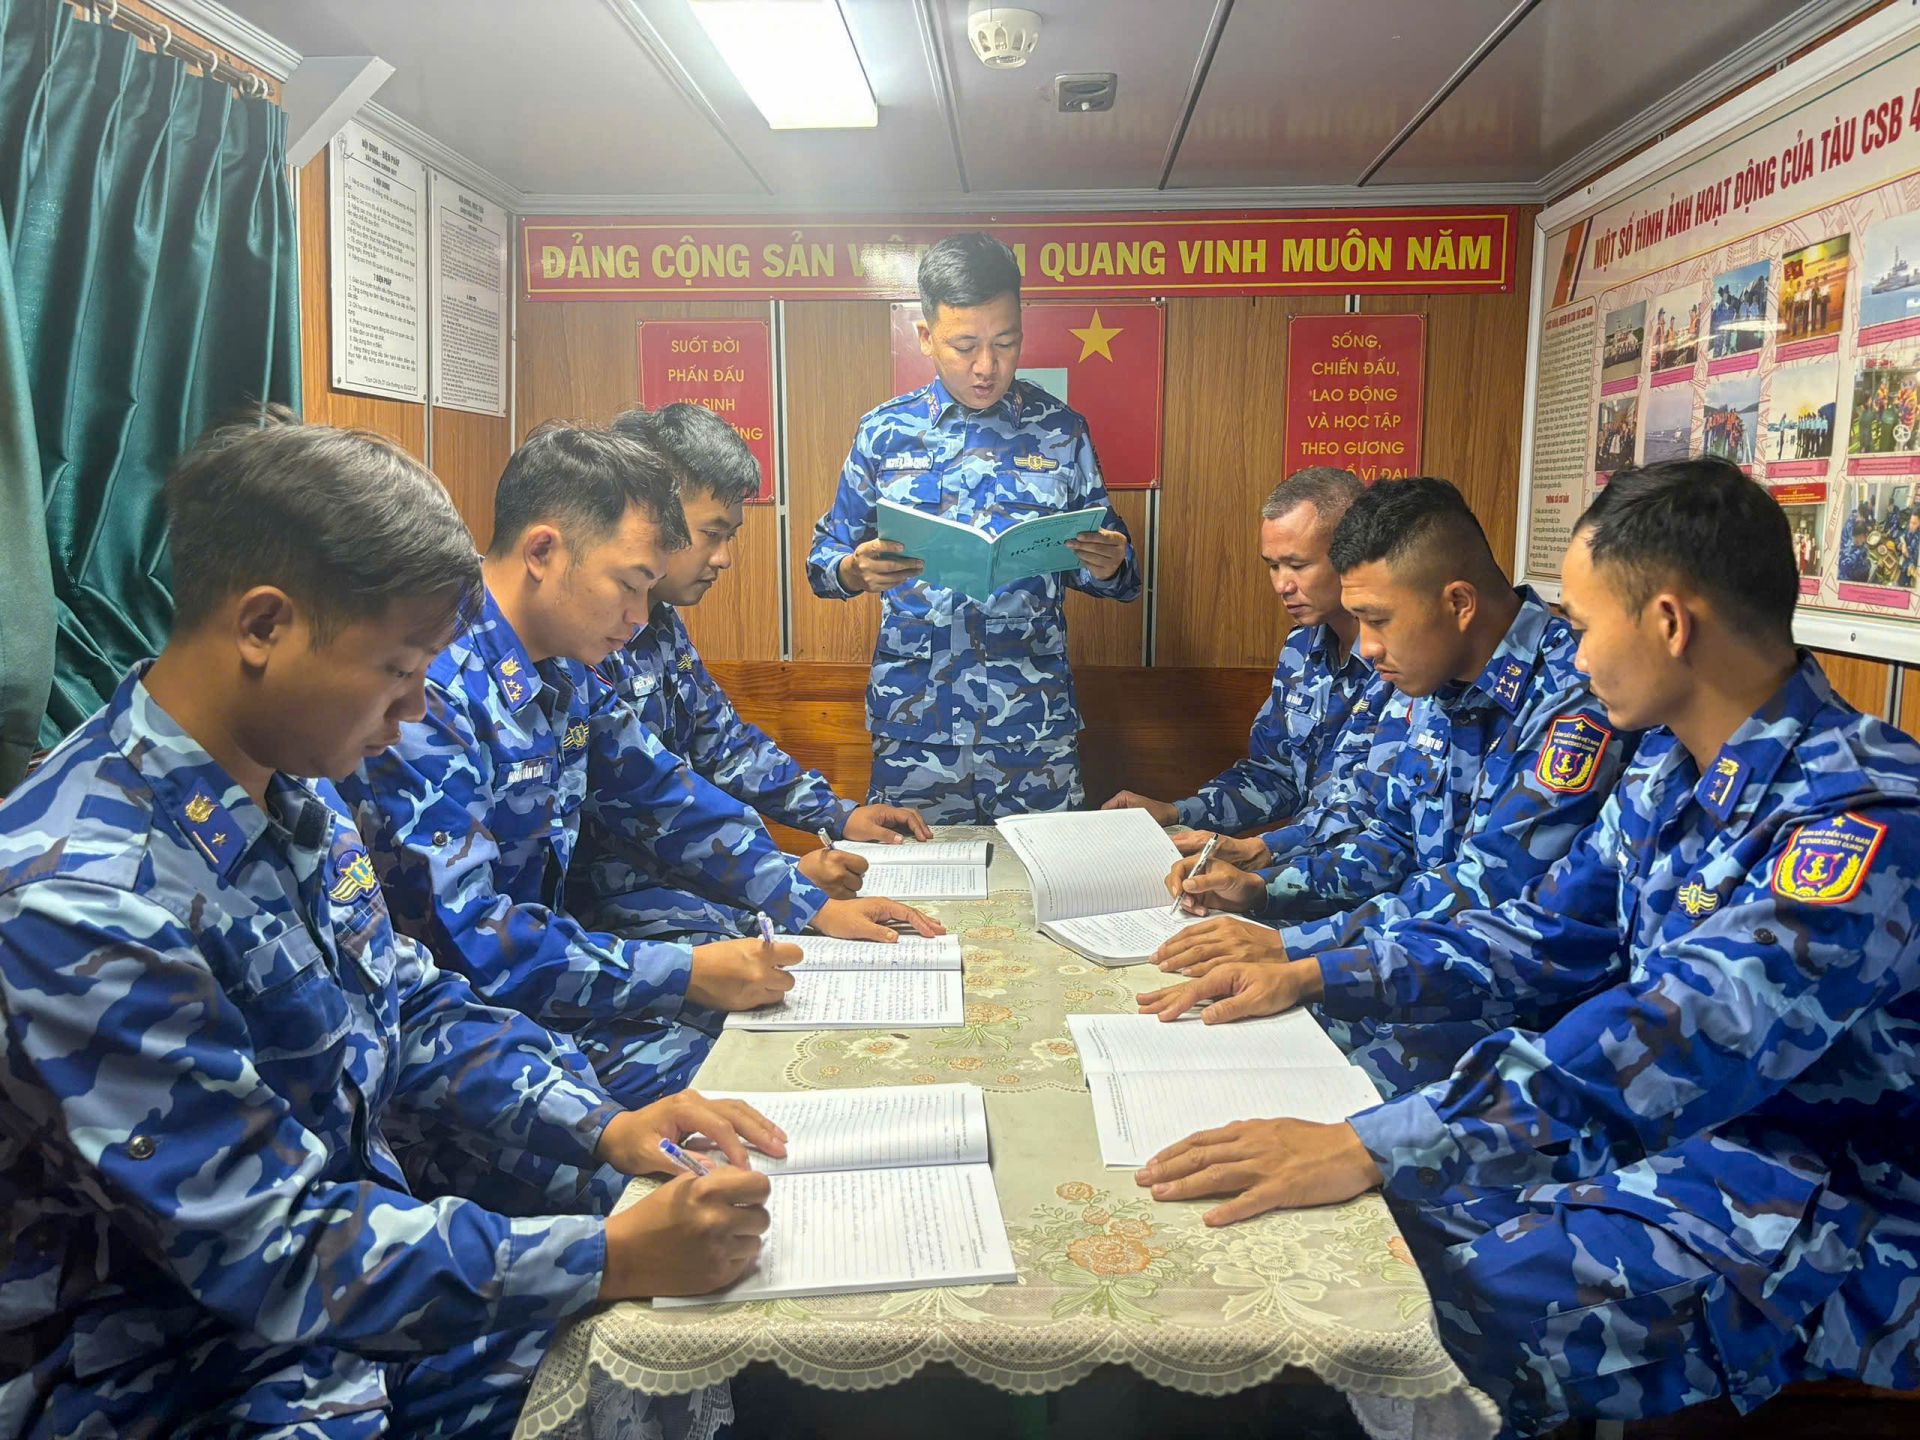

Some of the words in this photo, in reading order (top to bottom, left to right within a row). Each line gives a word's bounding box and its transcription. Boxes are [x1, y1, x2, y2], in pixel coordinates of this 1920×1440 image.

[1593, 227, 1617, 272] MỘT
[1617, 210, 1635, 259] SỐ
[1634, 209, 1664, 252] HÌNH
[1664, 192, 1693, 239] ẢNH
[1694, 176, 1731, 227] HOẠT
[1733, 156, 1777, 213] ĐỘNG
[1780, 129, 1814, 189] CỦA
[1820, 116, 1857, 173] TÀU
[1861, 95, 1904, 154] CSB
[541, 232, 640, 279] ĐẢNG
[651, 234, 750, 286] CỘNG
[761, 230, 834, 278] SẢN
[1039, 240, 1166, 282] QUANG
[1178, 239, 1267, 274] VINH
[1281, 228, 1393, 273] MUÔN
[1406, 228, 1492, 271] NĂM
[671, 335, 708, 353] SUỐT
[711, 336, 740, 353] ĐỜI
[1331, 330, 1382, 350] SỐNG,
[667, 364, 709, 382] PHẤN
[712, 365, 745, 382] ĐẤU
[1311, 357, 1358, 375] CHIẾN
[1363, 356, 1400, 377] ĐẤU,
[1312, 388, 1344, 402] LAO
[1348, 385, 1398, 404] ĐỘNG
[702, 398, 736, 411] SINH
[1306, 411, 1330, 428] VÀ
[1334, 415, 1370, 431] HỌC
[1374, 411, 1402, 431] TẬP
[1301, 441, 1339, 455] THEO
[1343, 440, 1405, 455] GƯƠNG
[1361, 465, 1377, 481] VĨ
